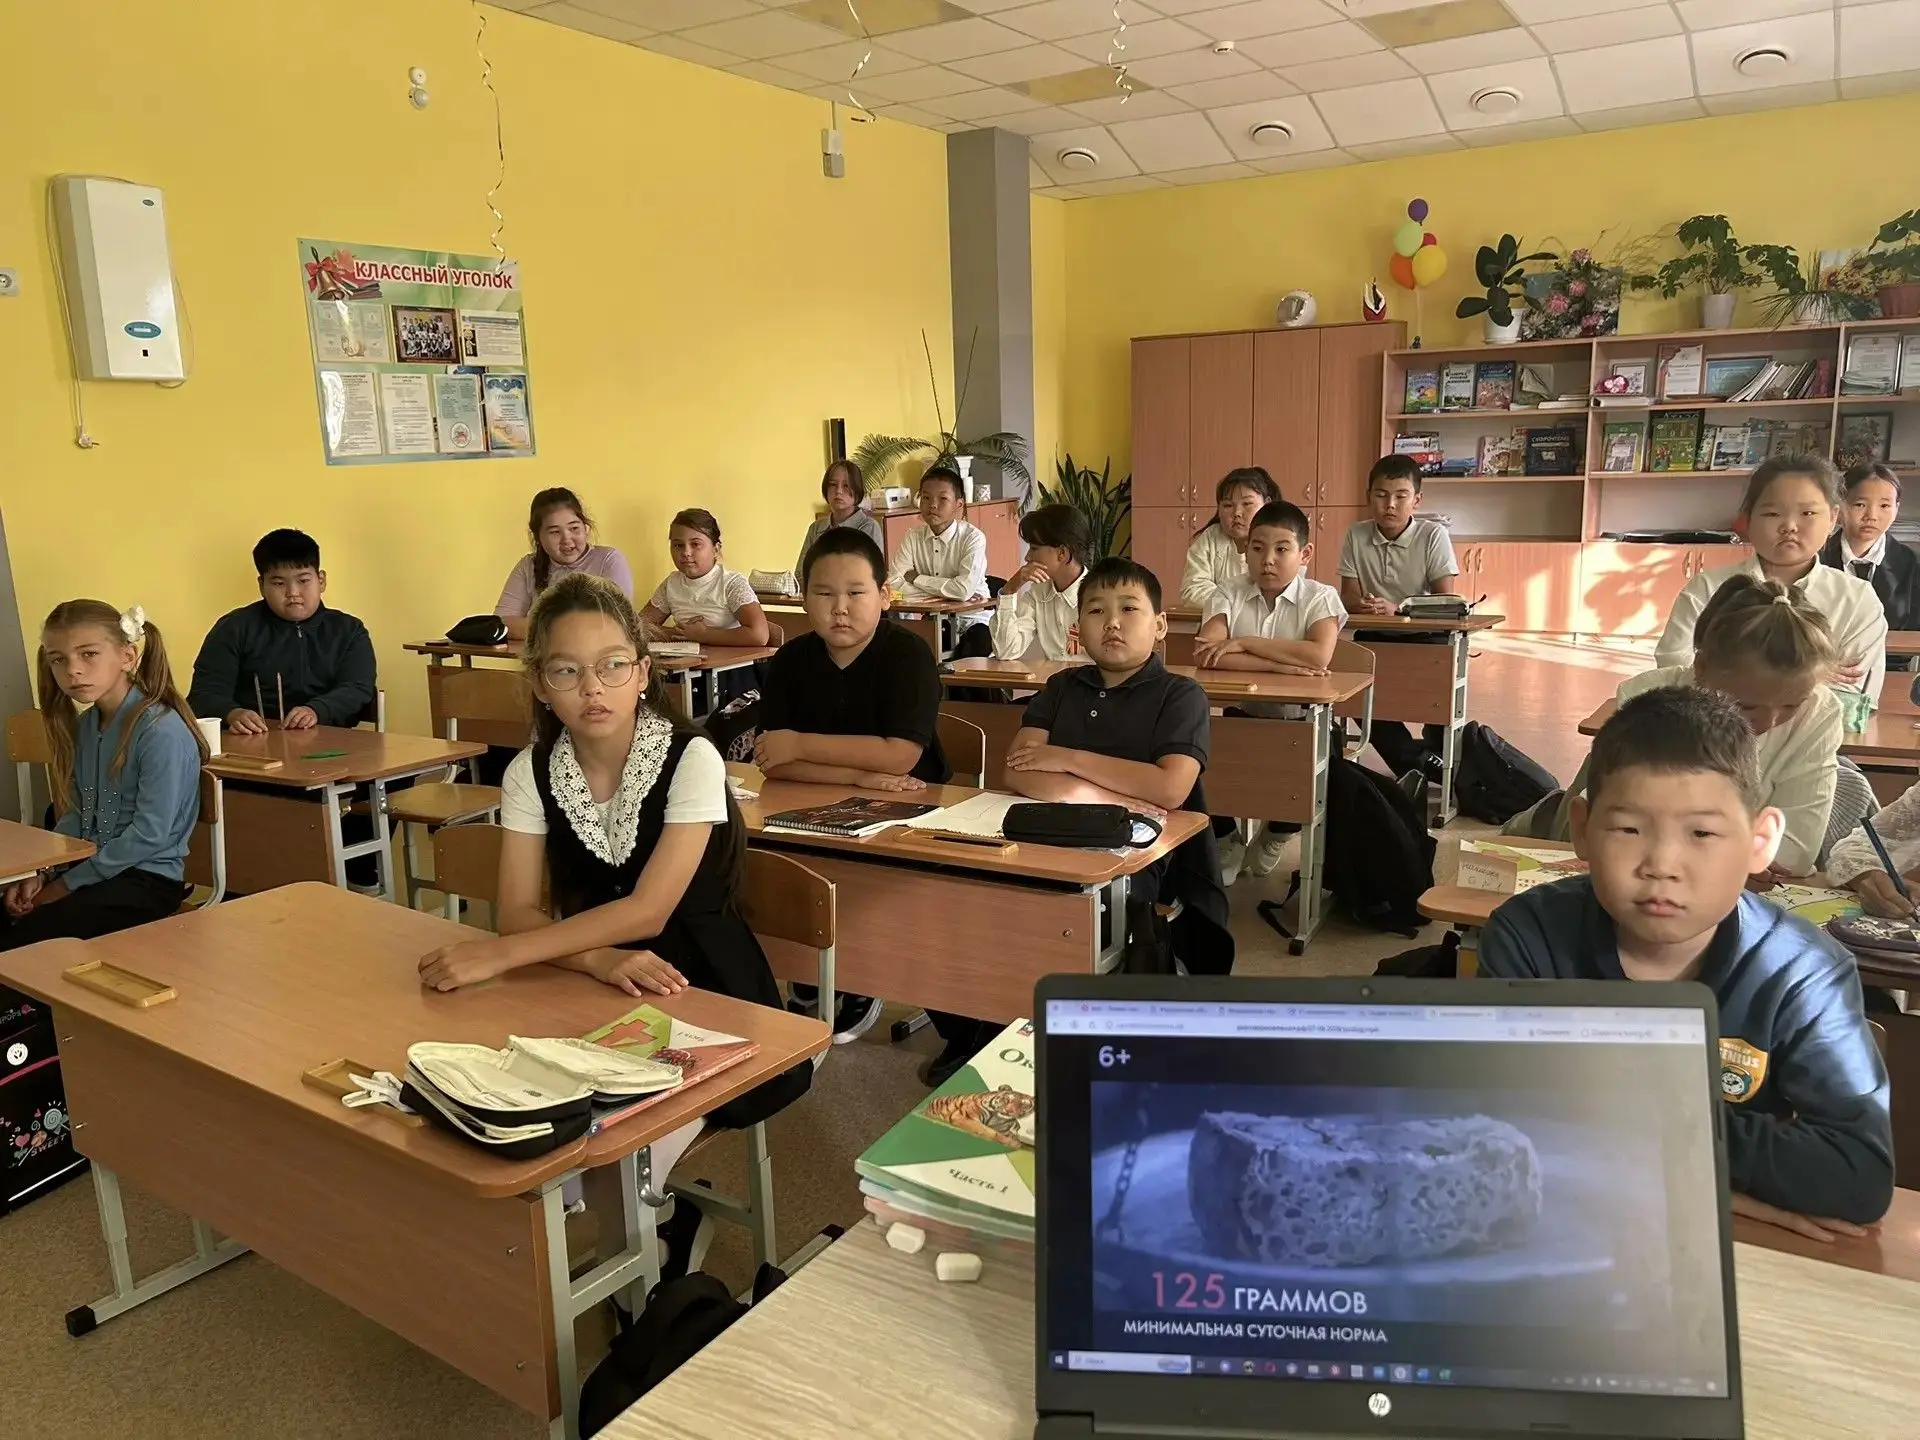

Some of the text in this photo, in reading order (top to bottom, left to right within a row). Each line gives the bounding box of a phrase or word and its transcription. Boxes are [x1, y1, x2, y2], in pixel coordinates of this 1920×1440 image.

[355, 261, 513, 289] КЛАССНЫЙ УГОЛОК
[1098, 1045, 1131, 1067] 6+
[1719, 1047, 1760, 1068] ENIUS
[1151, 1271, 1368, 1315] 125 ГРАММОВ
[1123, 1319, 1388, 1343] МИНИМАЛЬНАЯ СУТОЧНАЯ НОРМА
